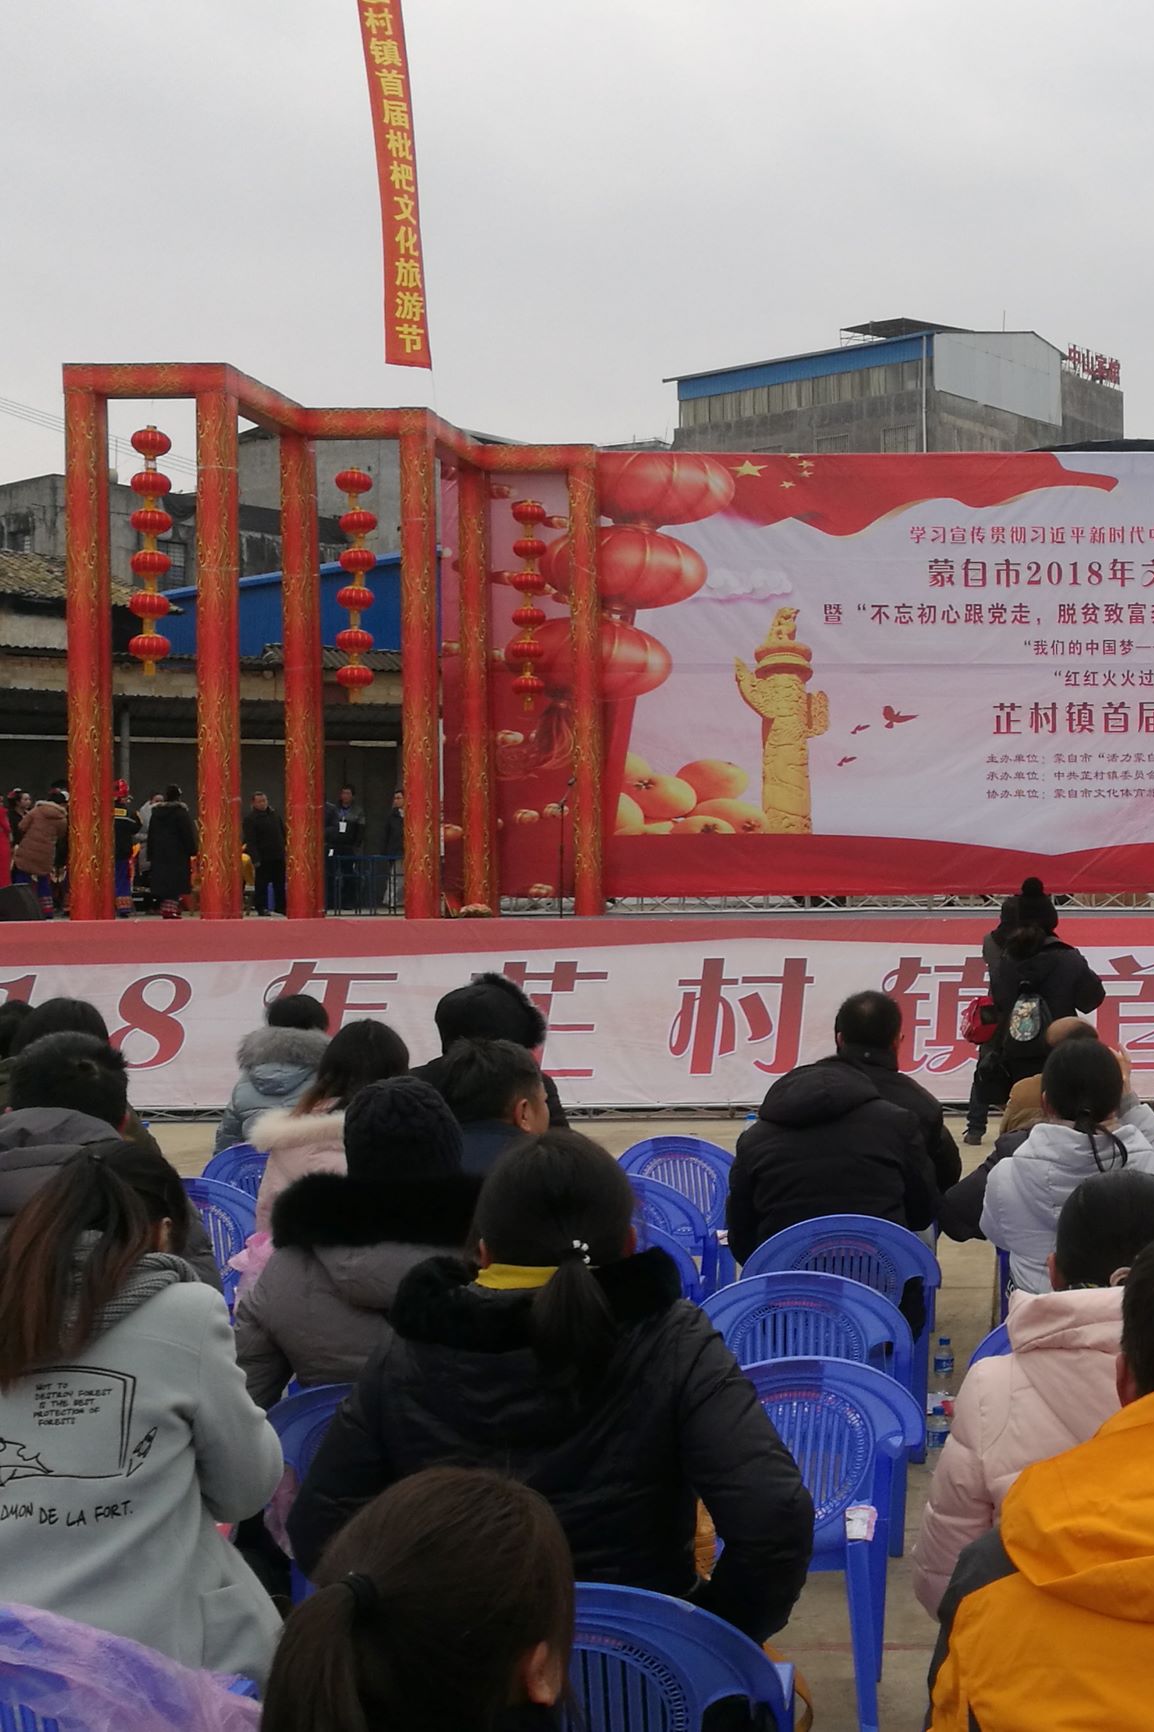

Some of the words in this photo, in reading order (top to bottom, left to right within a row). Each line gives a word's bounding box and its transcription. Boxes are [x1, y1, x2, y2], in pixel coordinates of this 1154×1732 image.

[363, 0, 425, 353] 村镇首届枇杷文化旅游节
[78, 1388, 113, 1397] FOREST
[39, 1507, 58, 1525] DE
[66, 1509, 87, 1526] LA
[94, 1500, 133, 1521] FORT.
